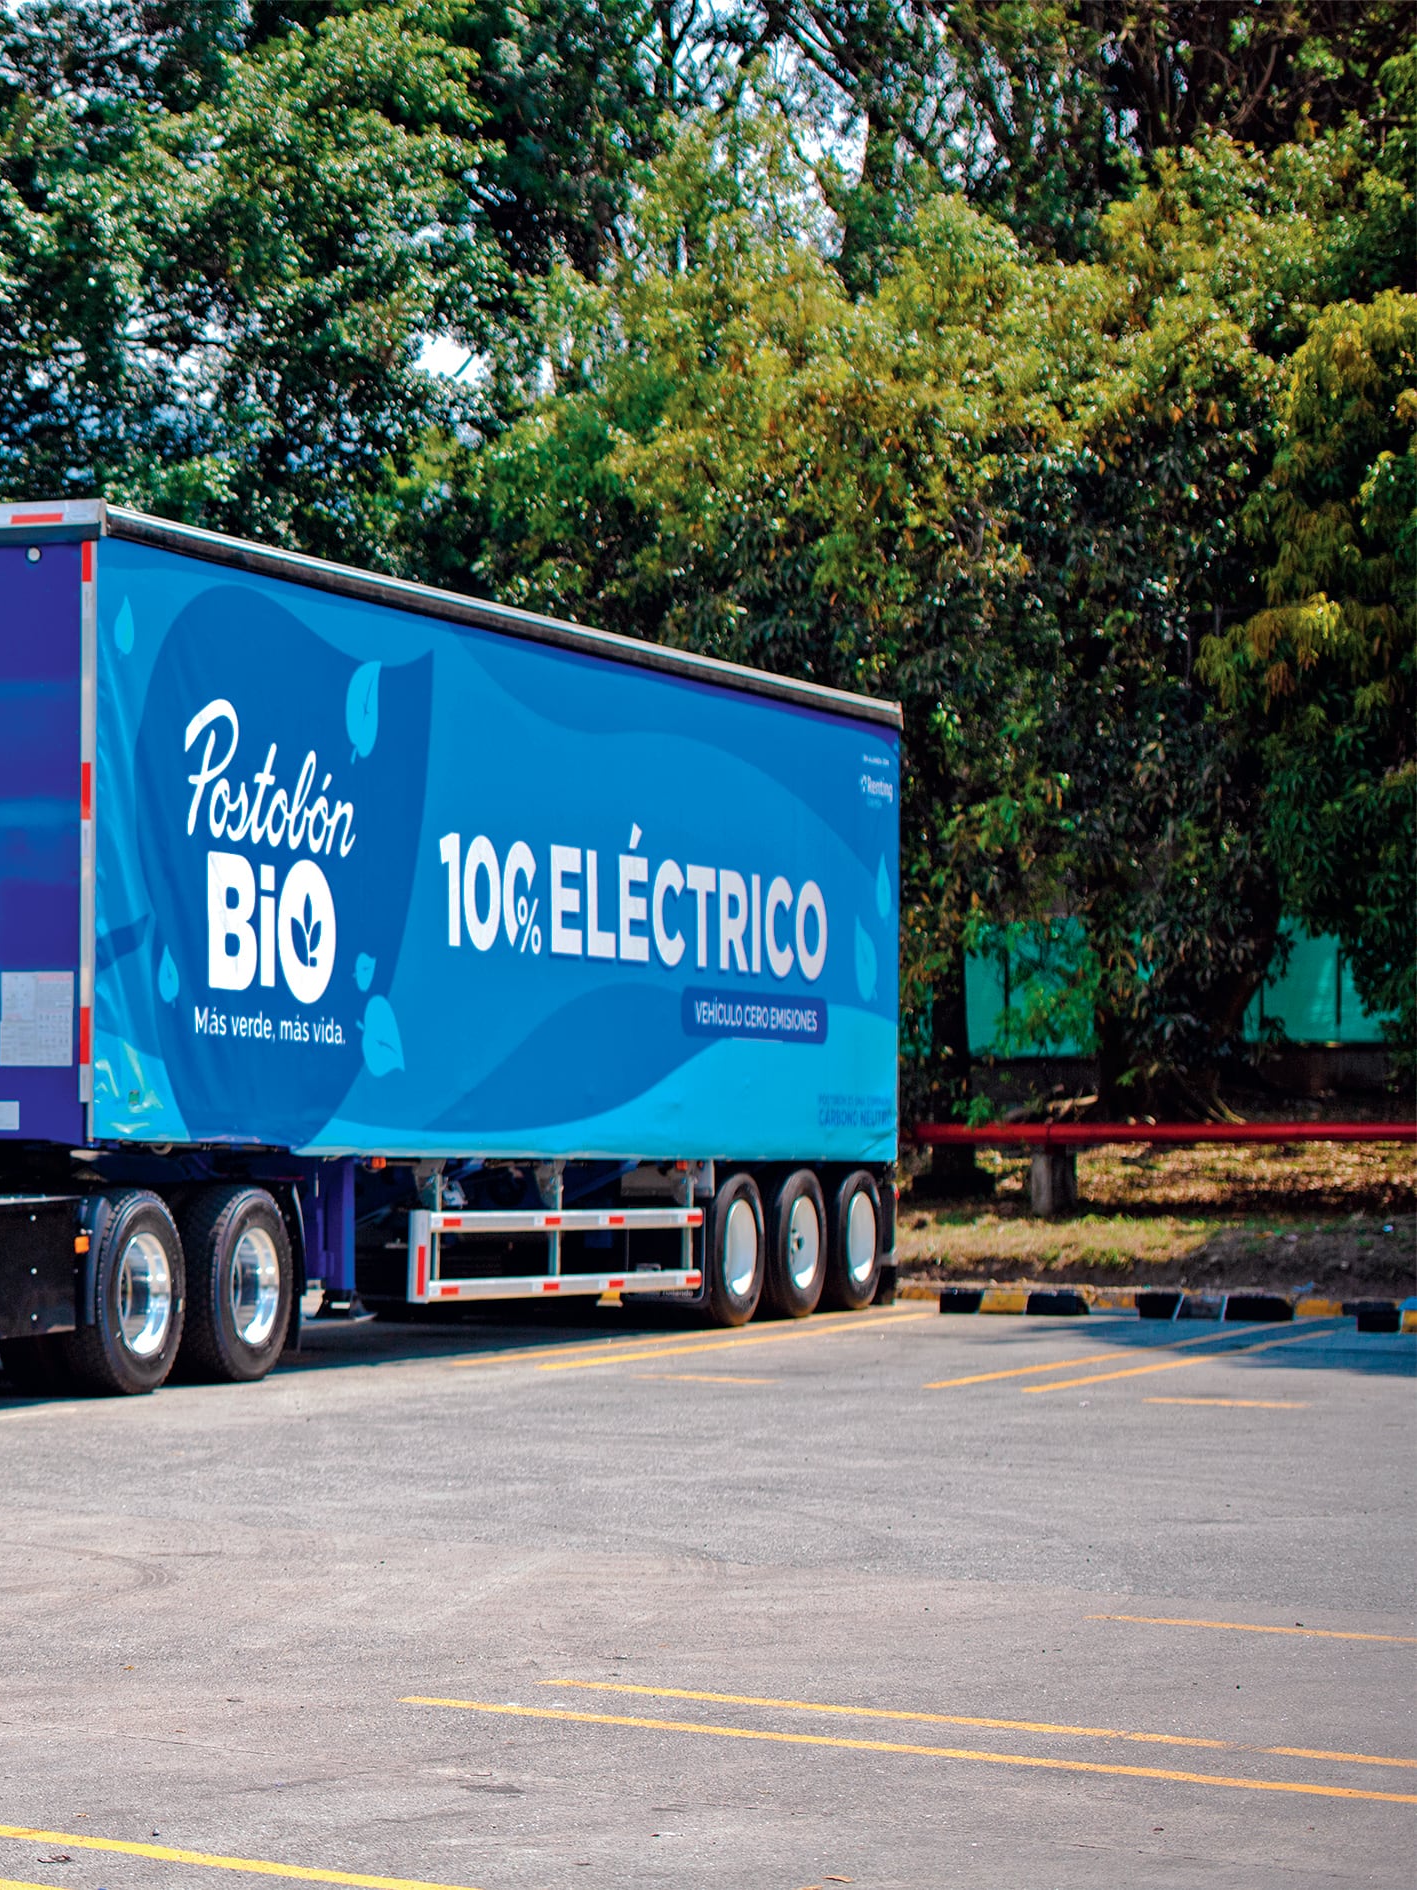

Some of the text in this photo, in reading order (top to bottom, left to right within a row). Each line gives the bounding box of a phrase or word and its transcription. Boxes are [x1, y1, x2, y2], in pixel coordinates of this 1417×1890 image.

[185, 698, 356, 857] Postobón
[439, 822, 829, 982] 100% ELÉCTRICO
[194, 1006, 346, 1044] Más verde, más vida.
[695, 996, 818, 1032] VEHÍCULO CERO EMISIONES
